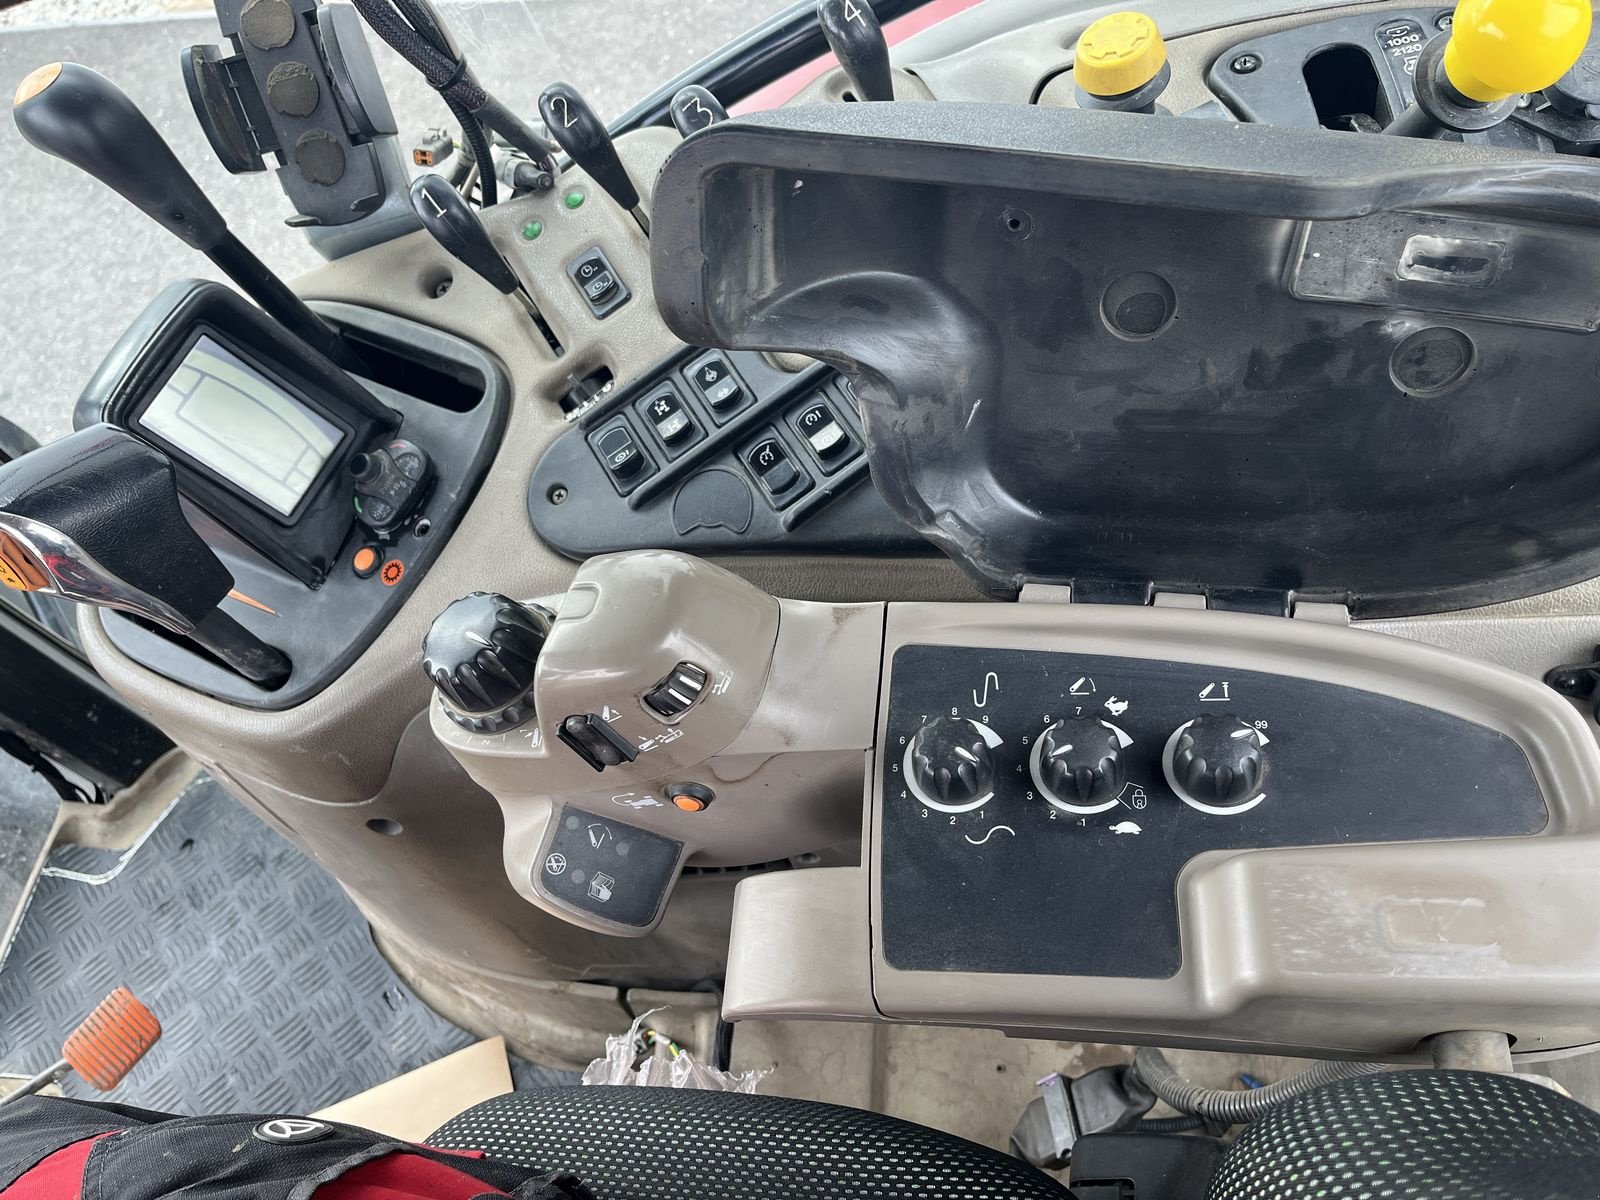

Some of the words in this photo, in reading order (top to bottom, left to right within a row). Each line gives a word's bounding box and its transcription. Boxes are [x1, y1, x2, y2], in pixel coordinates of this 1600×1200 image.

[844, 0, 866, 27] 4
[1387, 34, 1419, 47] 1000
[1392, 43, 1422, 57] 2120
[550, 96, 579, 128] 2
[682, 96, 713, 127] 3
[421, 187, 447, 218] 1
[951, 707, 958, 716] 8
[1075, 706, 1082, 715] 7
[921, 715, 927, 723] 7
[982, 715, 989, 724] 9
[1043, 715, 1050, 723] 6
[1254, 720, 1268, 729] 99
[899, 736, 906, 745] 6
[1022, 736, 1029, 745] 5
[892, 763, 899, 772] 5
[1016, 764, 1022, 773] 4
[900, 790, 907, 799] 4
[1026, 791, 1033, 800] 3
[921, 809, 928, 818] 3
[979, 810, 985, 819] 1
[1049, 810, 1057, 820] 2
[949, 816, 957, 825] 2
[1080, 818, 1086, 827] 1
